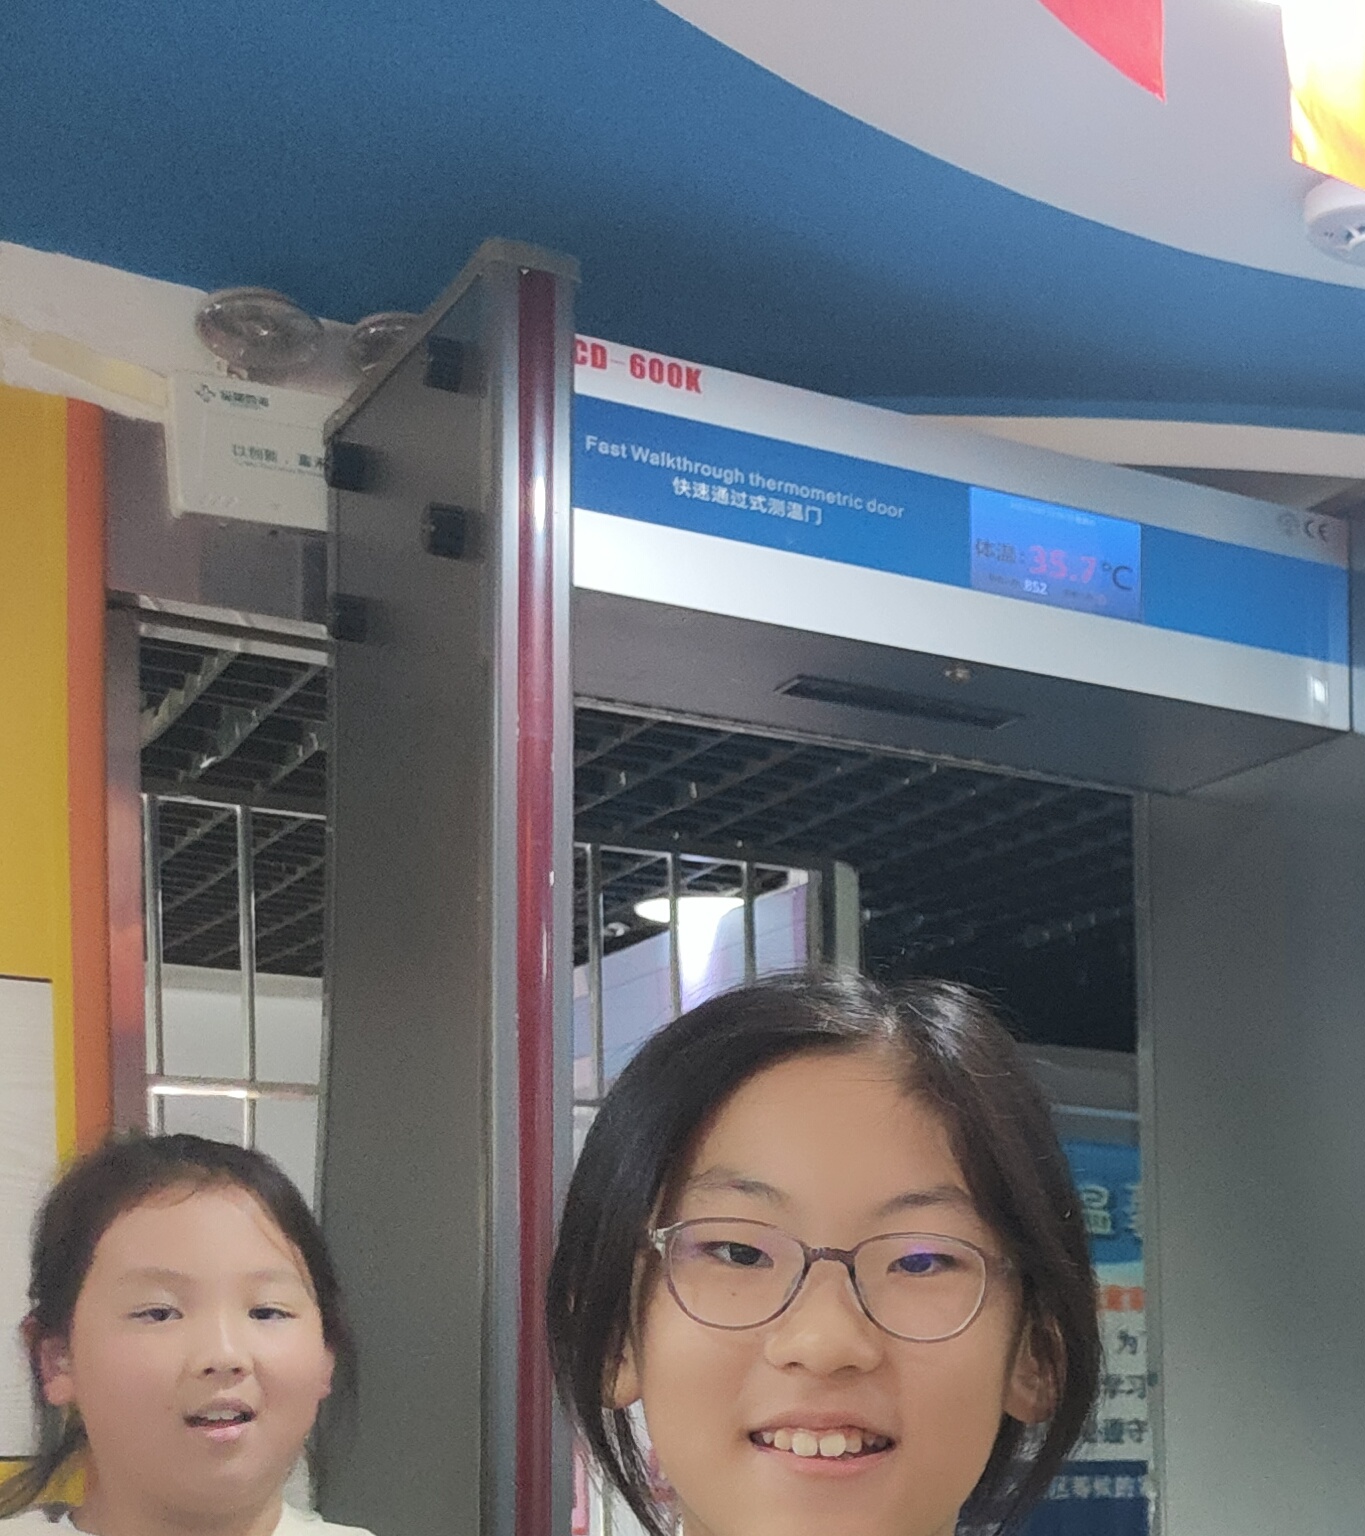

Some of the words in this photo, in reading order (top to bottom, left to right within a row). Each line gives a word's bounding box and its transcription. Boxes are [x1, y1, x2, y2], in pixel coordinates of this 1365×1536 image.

[585, 435, 628, 460] Fast
[631, 444, 745, 485] Walkthrough
[748, 470, 863, 511] thermometric
[867, 498, 905, 520] door
[672, 476, 823, 526] 快速通过式测温门
